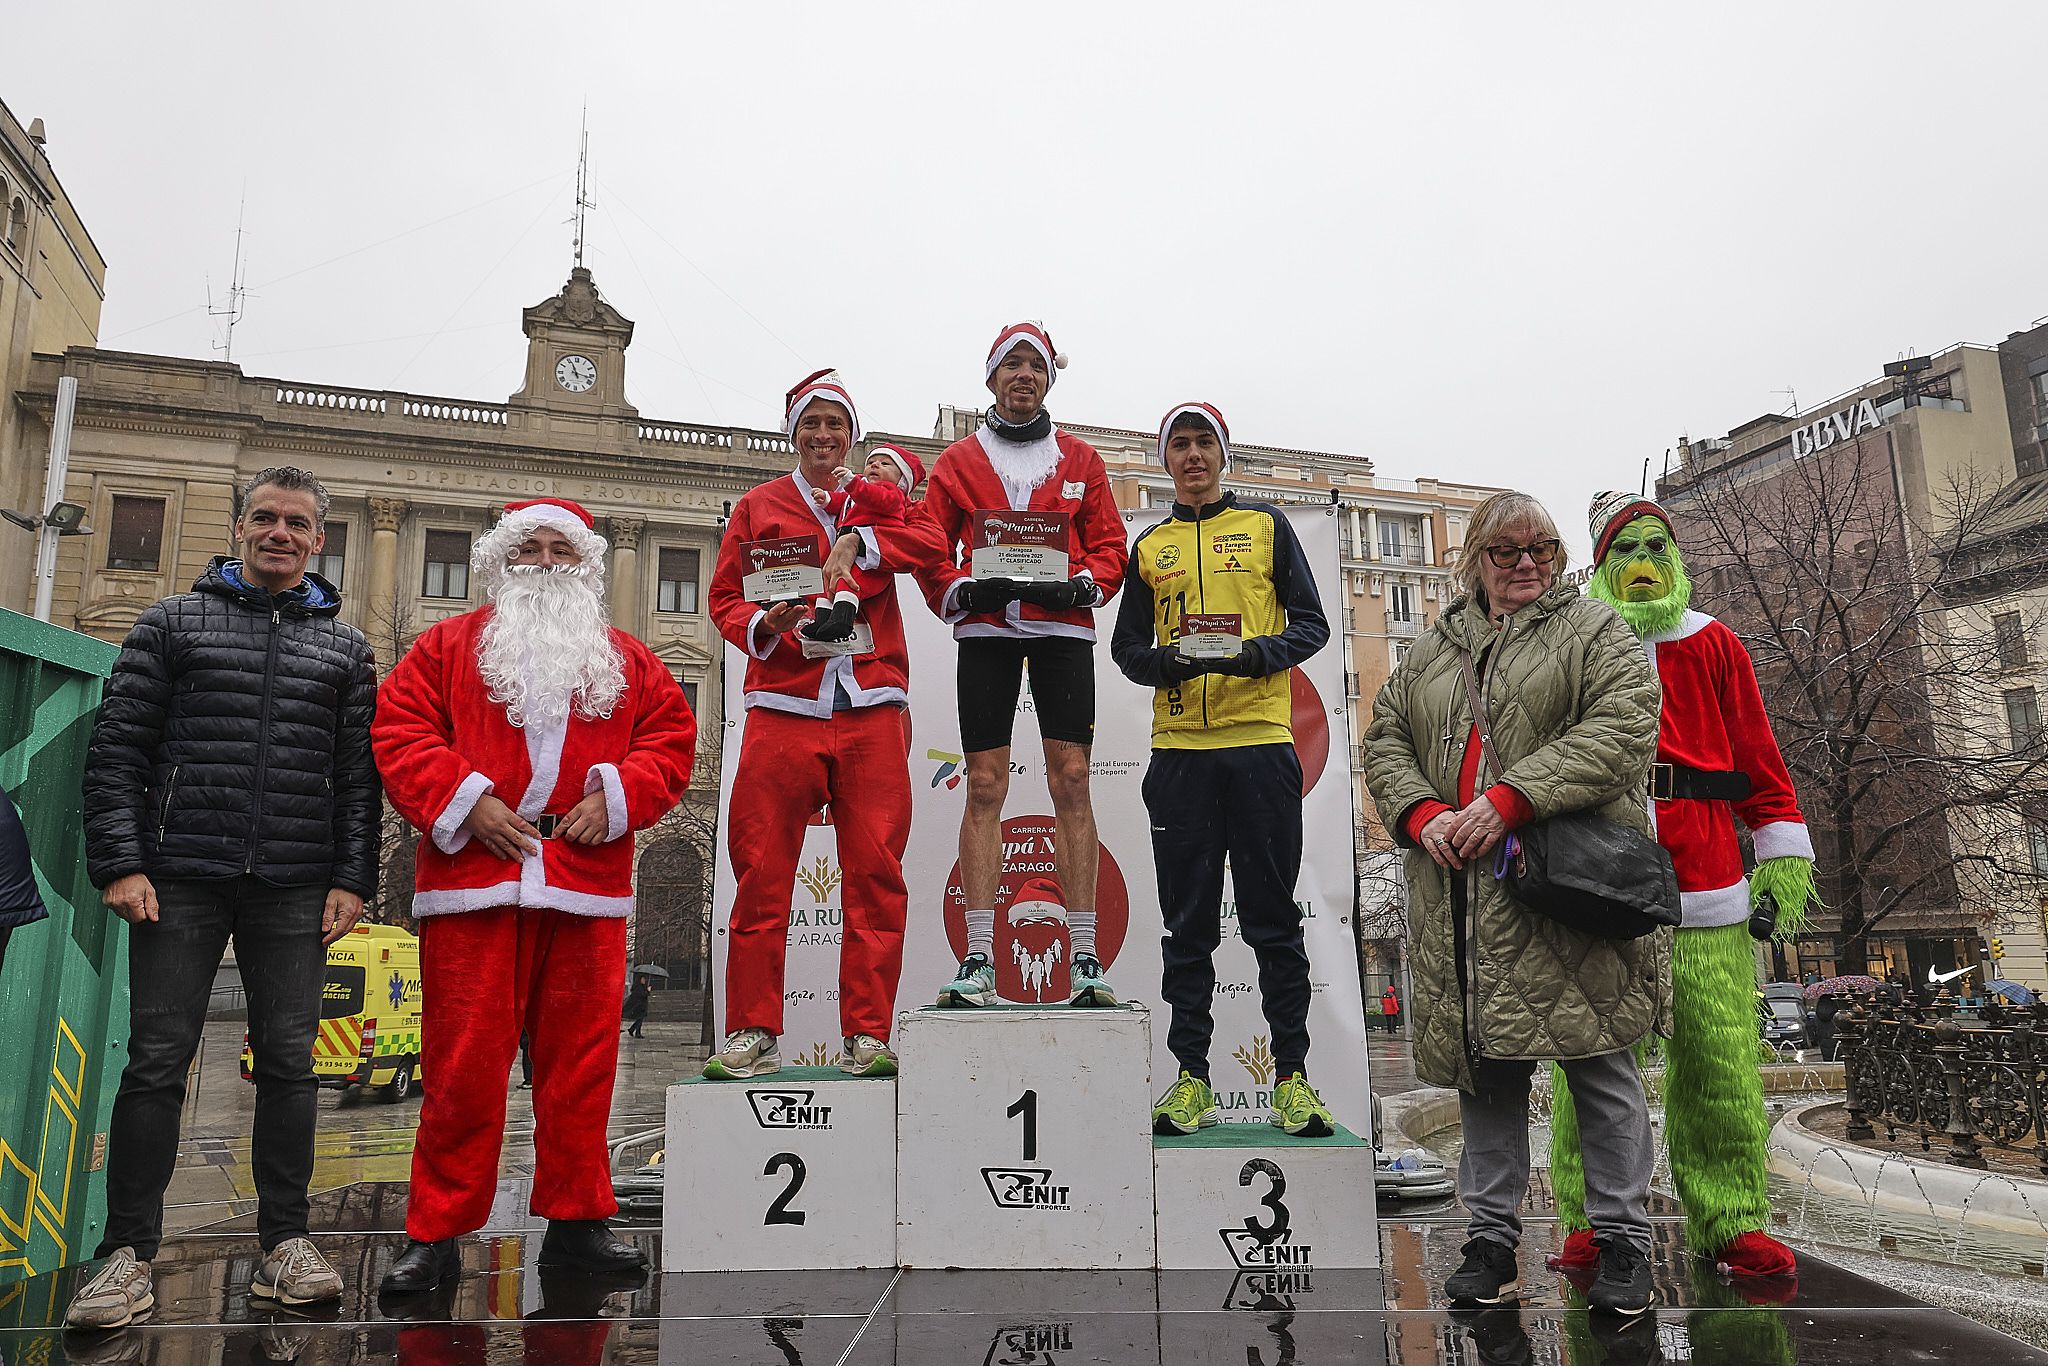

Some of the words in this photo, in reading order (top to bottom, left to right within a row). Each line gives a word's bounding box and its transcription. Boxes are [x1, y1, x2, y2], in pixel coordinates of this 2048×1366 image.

[1791, 399, 1881, 460] BBVA
[583, 484, 722, 508] PROVINCIAL
[1007, 523, 1034, 534] Papá
[1036, 524, 1061, 533] Noel
[769, 547, 790, 558] Papá
[791, 545, 811, 555] Noel
[1154, 569, 1186, 585] Alcampo
[1112, 760, 1140, 768] Europea
[1002, 862, 1057, 873] ZARAGO
[815, 908, 842, 926] RU
[798, 932, 842, 946] ARAG
[328, 952, 355, 961] NCIA
[1007, 1090, 1037, 1161] 1
[763, 1152, 807, 1226] 2
[1239, 1158, 1290, 1241] 3
